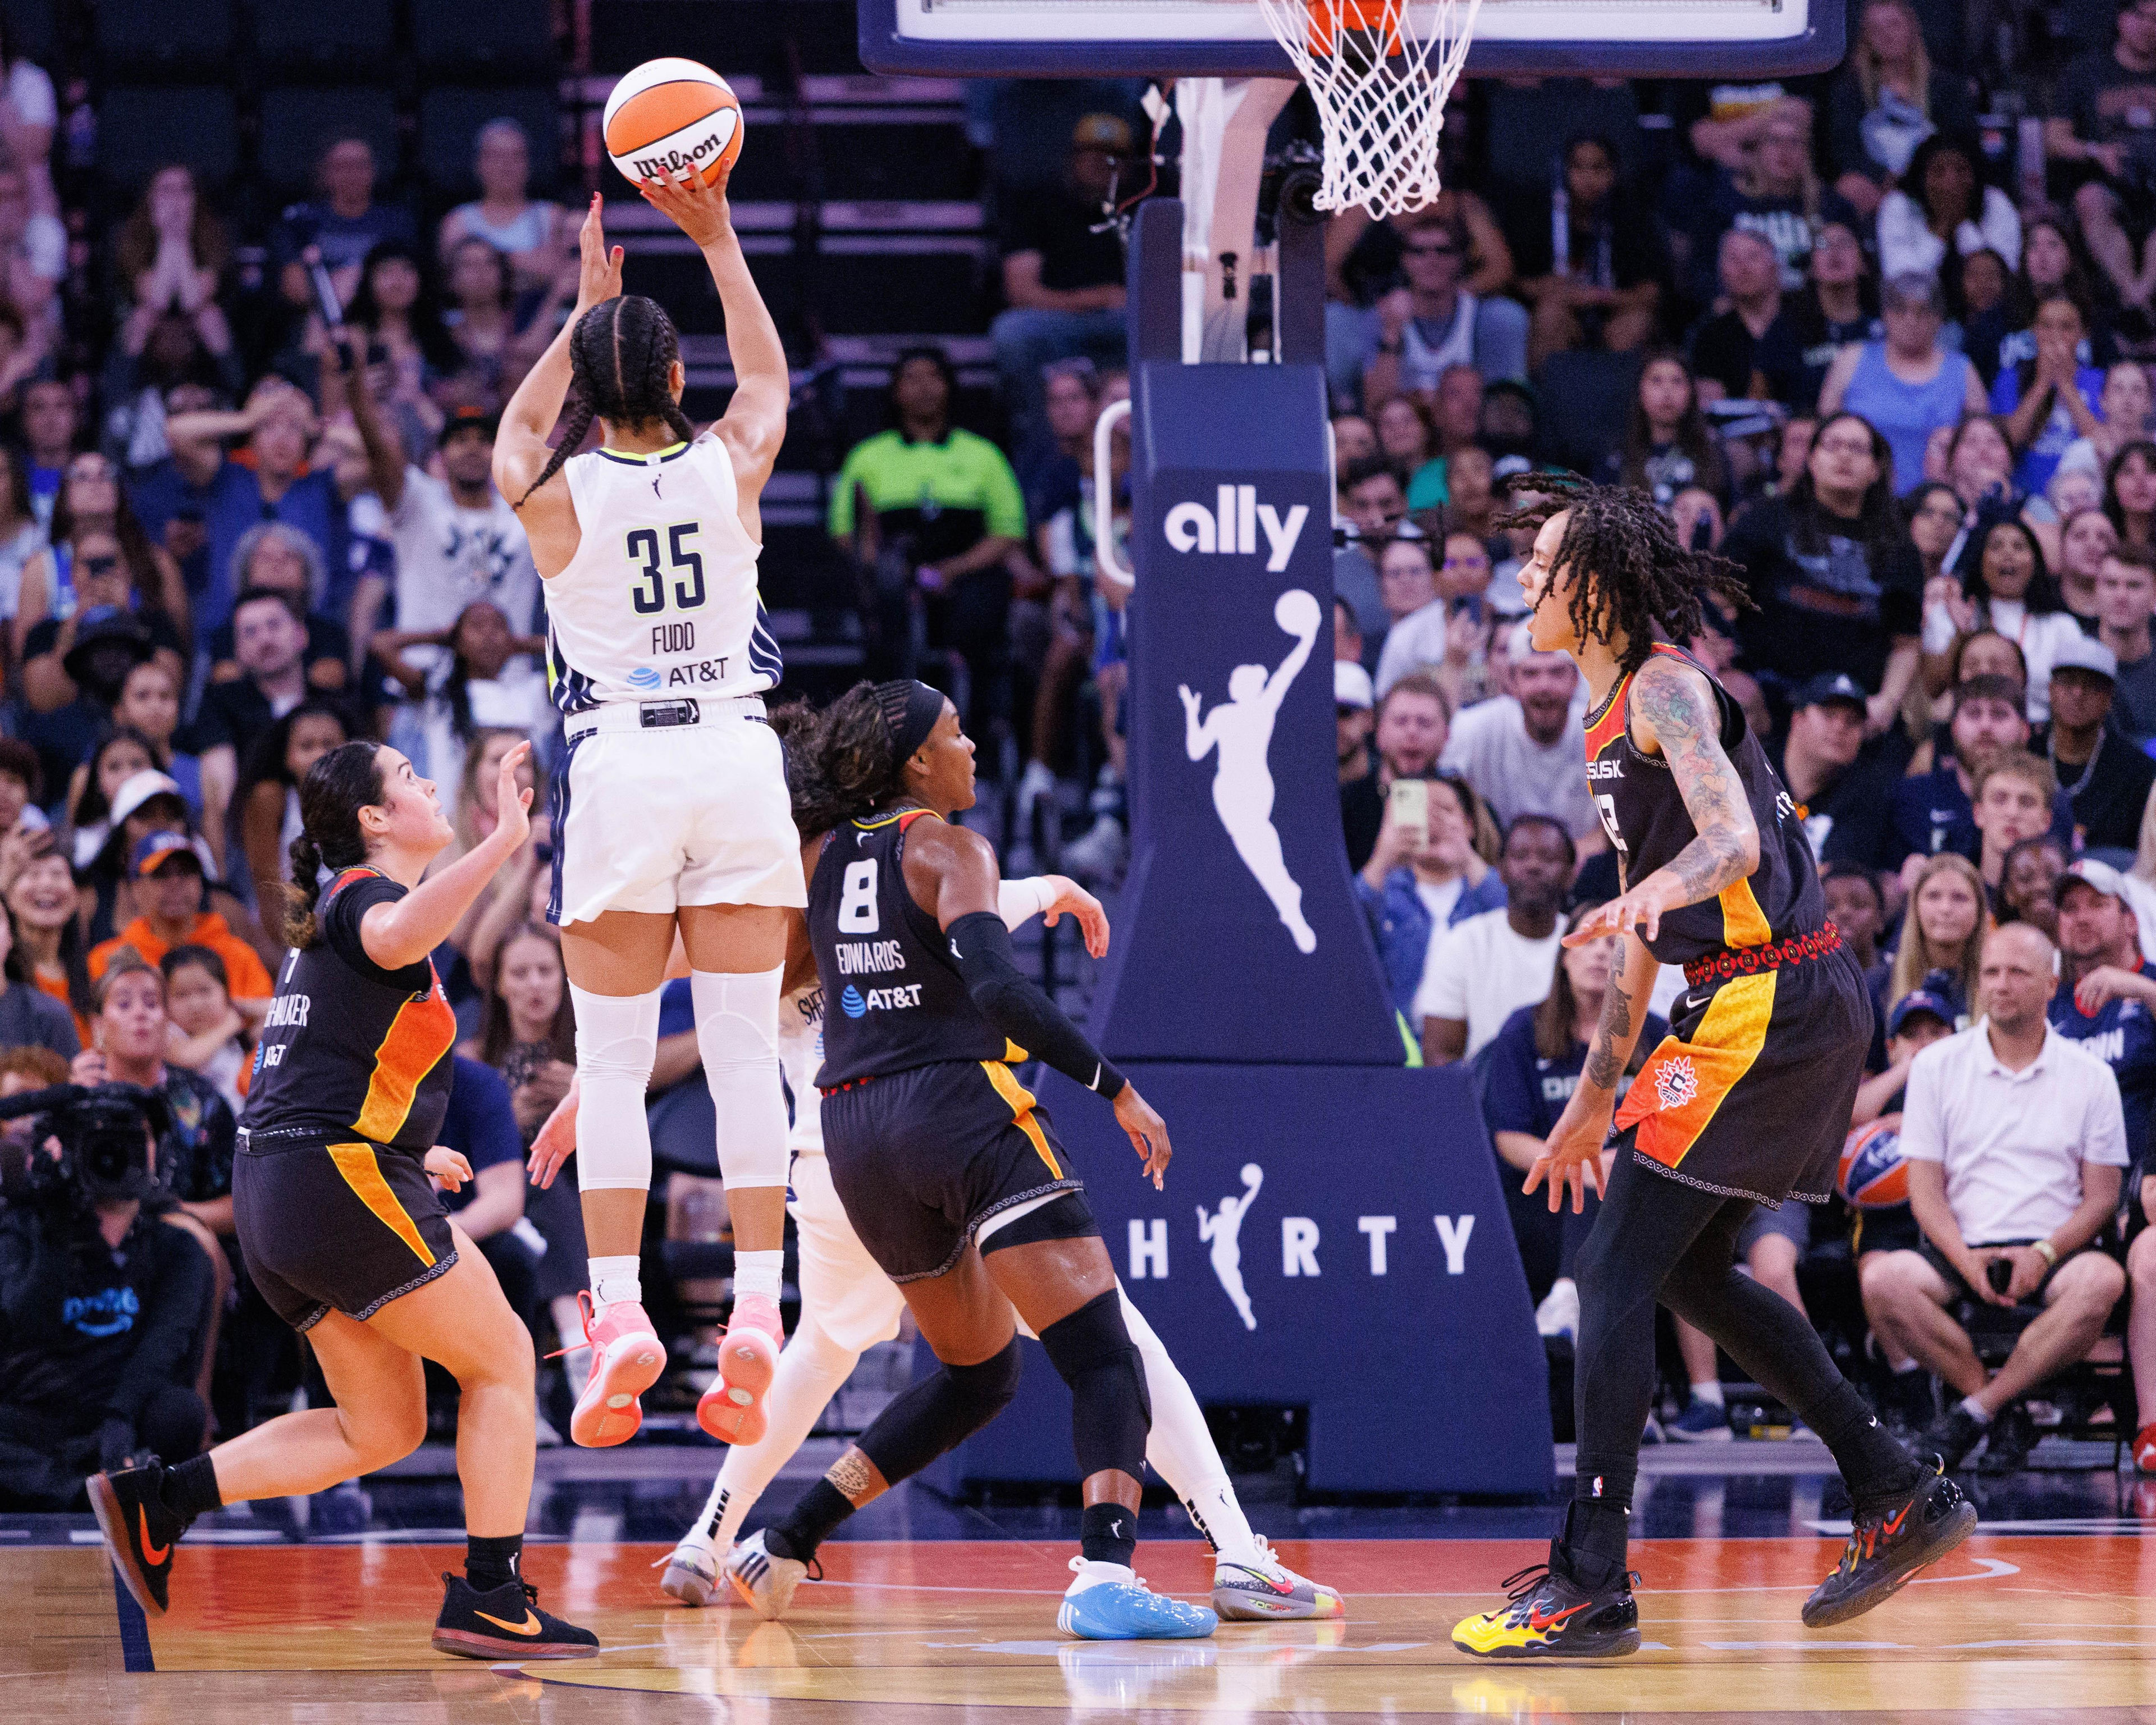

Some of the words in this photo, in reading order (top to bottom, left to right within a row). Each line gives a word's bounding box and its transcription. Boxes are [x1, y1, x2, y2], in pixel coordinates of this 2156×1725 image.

[633, 134, 722, 179] Wilson
[1163, 483, 1310, 573] ally
[624, 520, 708, 616] 35
[652, 621, 695, 655] FUDD
[669, 656, 729, 688] AT&T
[837, 857, 880, 934] 8
[835, 939, 906, 975] EDWARDS
[867, 983, 922, 1011] AT&T
